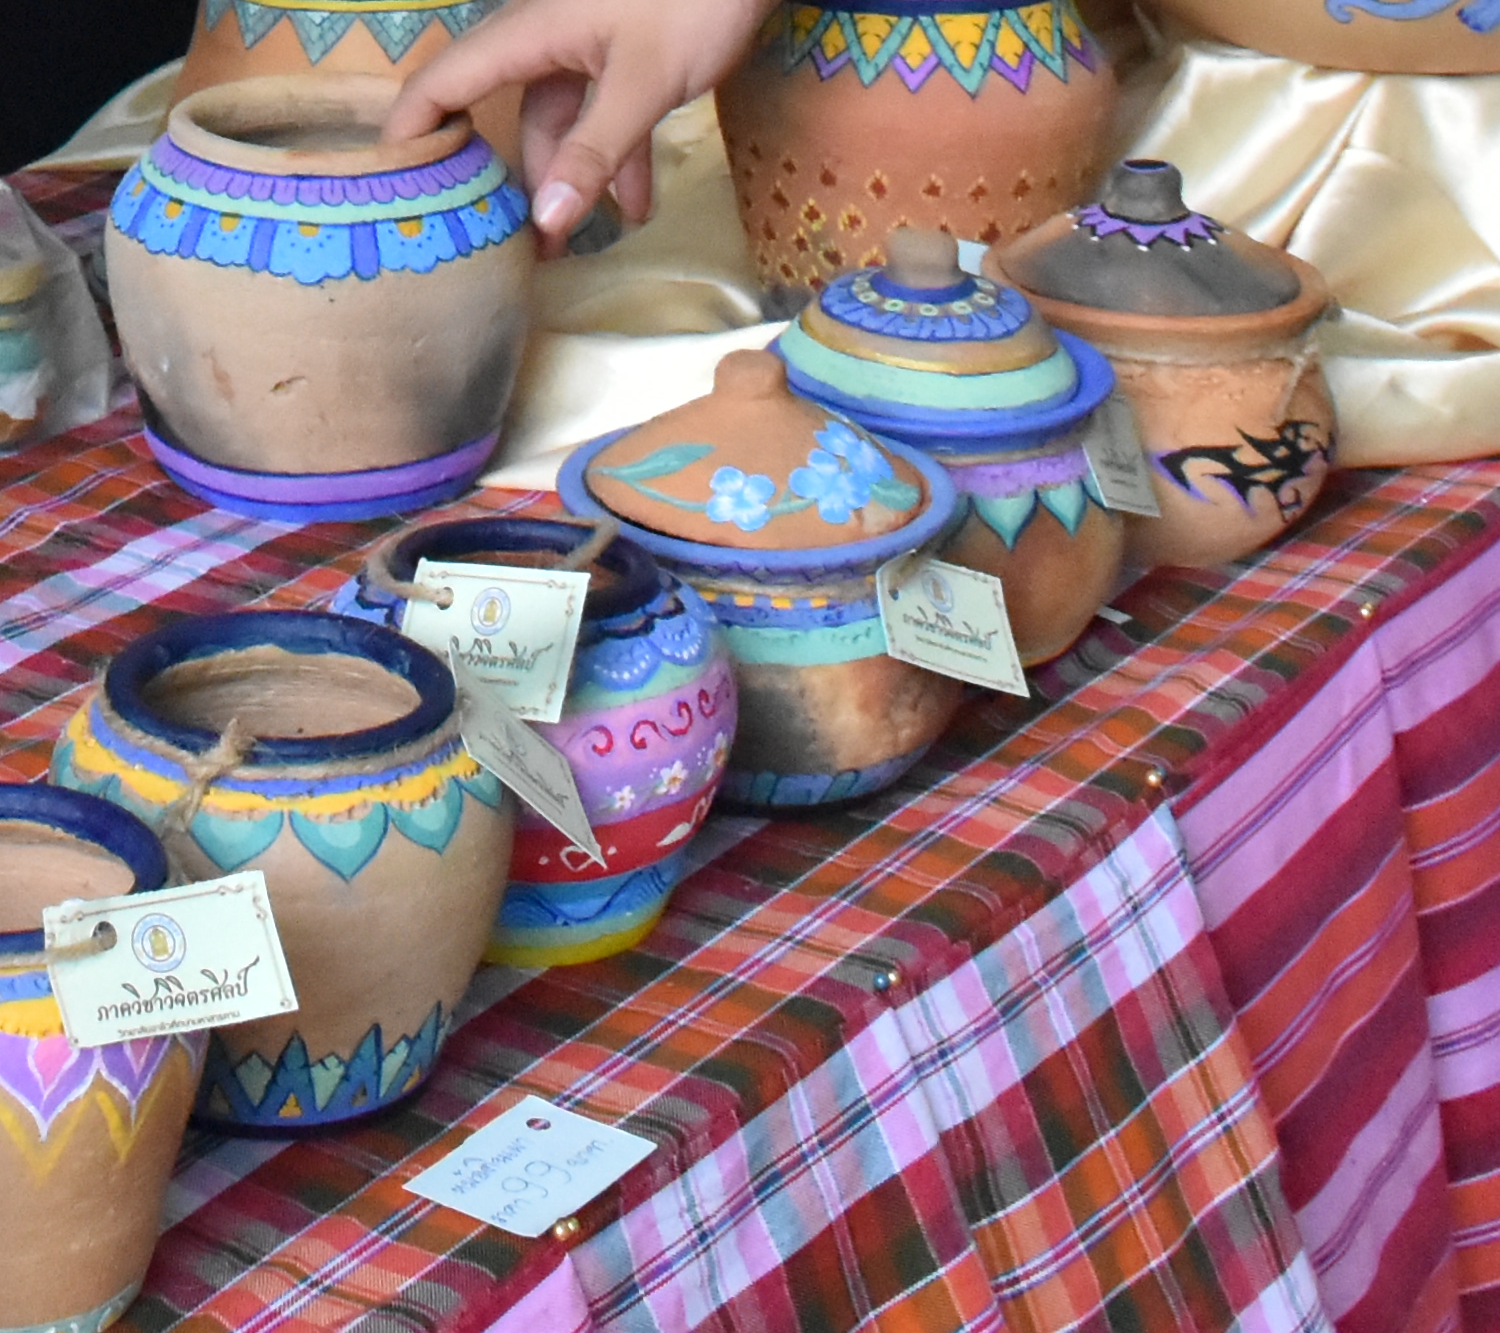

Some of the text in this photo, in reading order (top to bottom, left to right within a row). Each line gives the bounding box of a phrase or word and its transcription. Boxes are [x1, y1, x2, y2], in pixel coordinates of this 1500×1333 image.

[97, 955, 260, 1023] ภาควิชาวิจิตรศิลป์
[501, 1159, 573, 1199] 99
